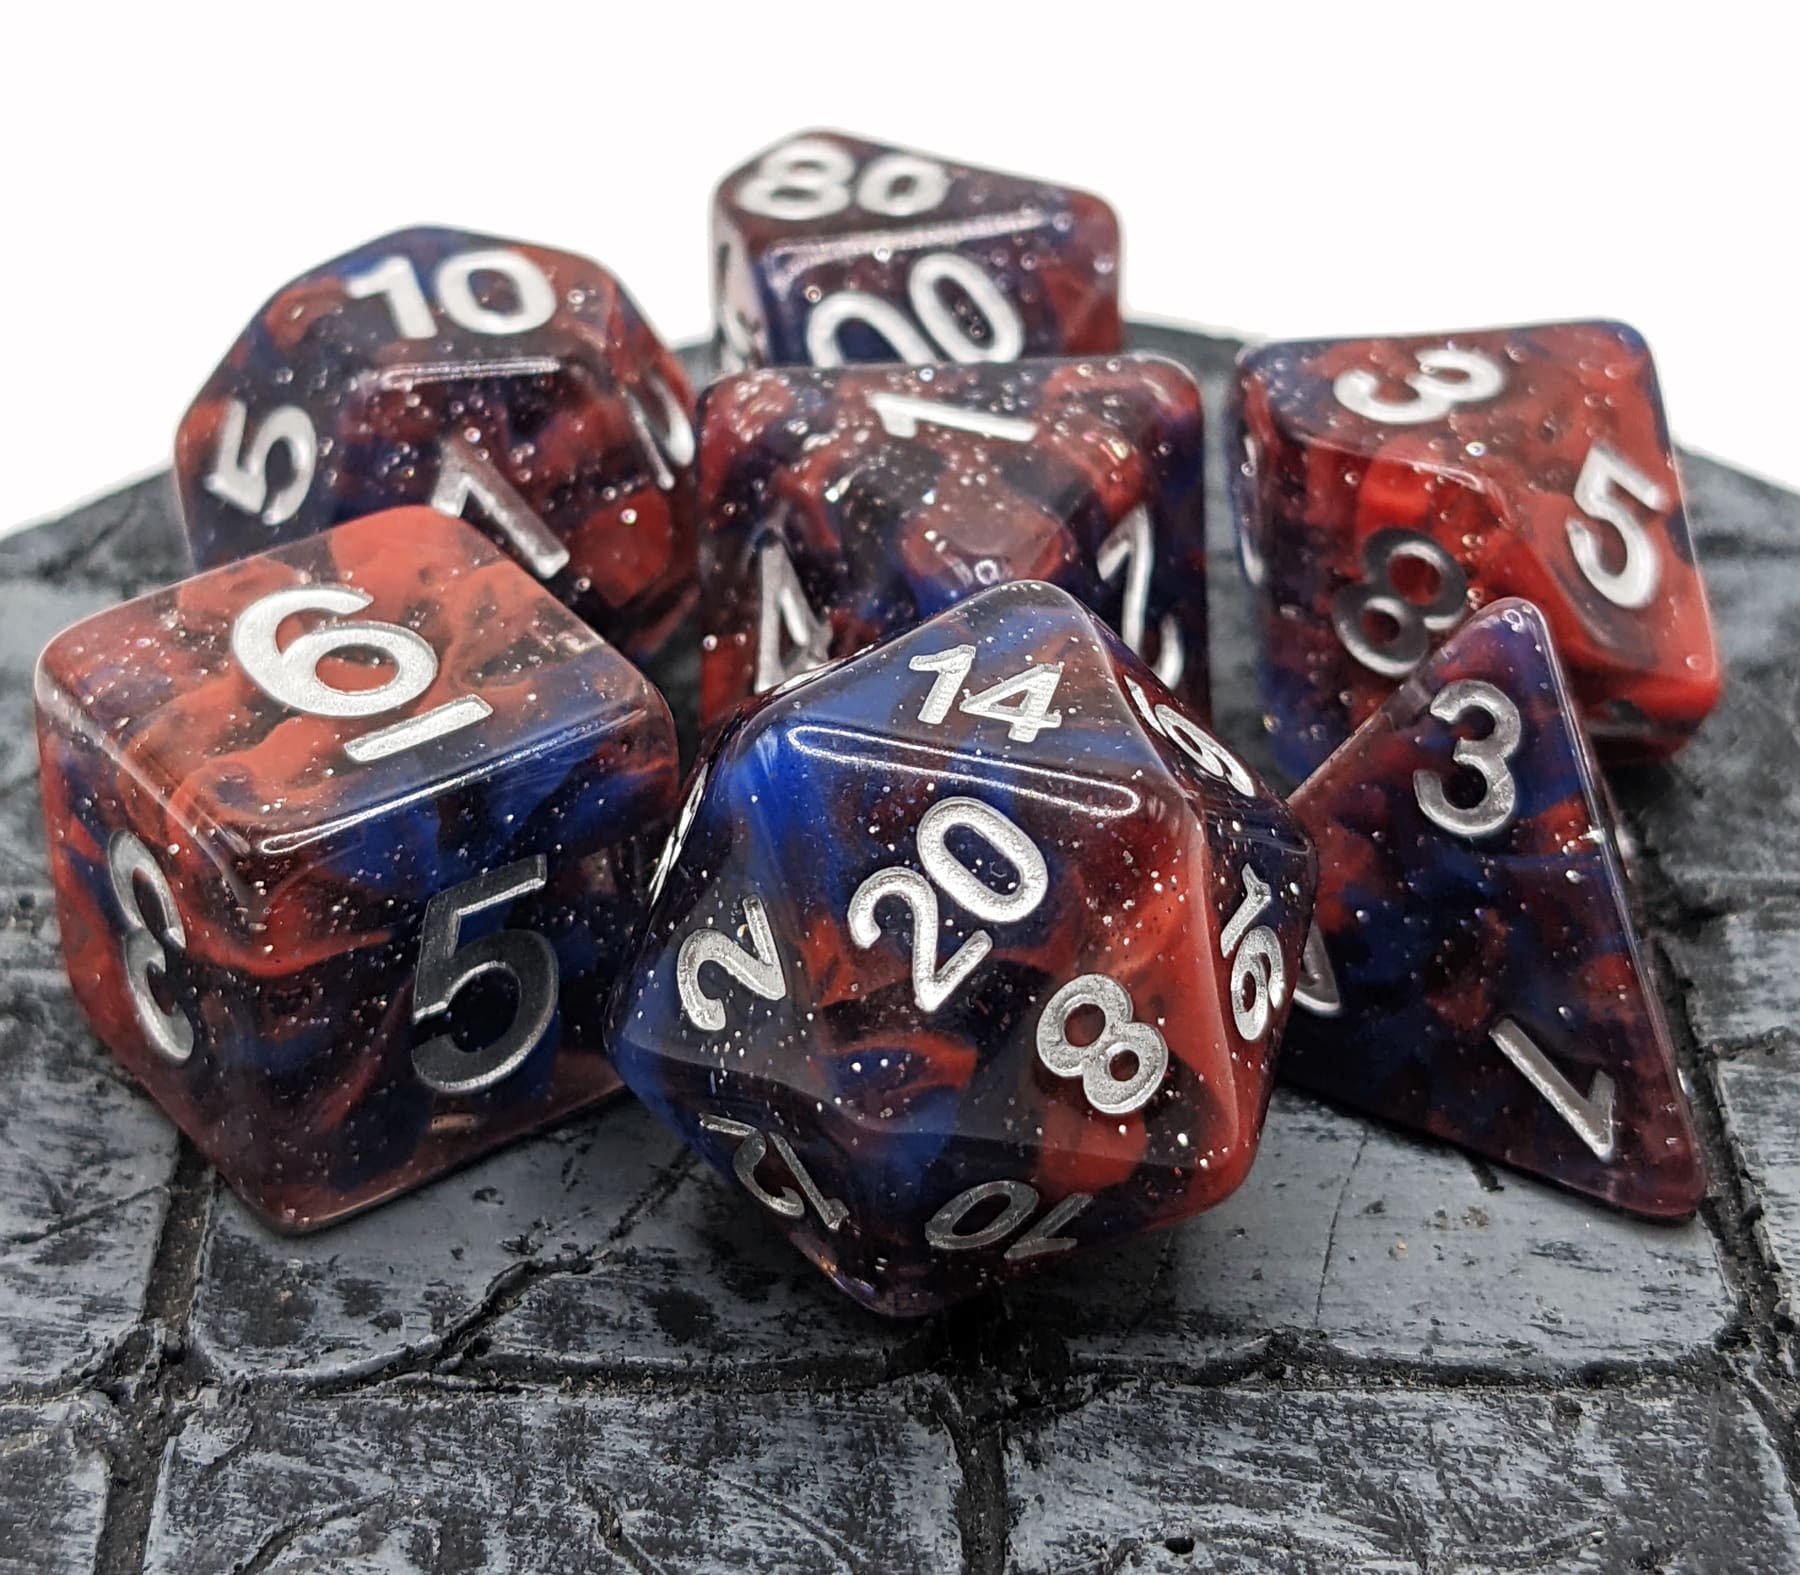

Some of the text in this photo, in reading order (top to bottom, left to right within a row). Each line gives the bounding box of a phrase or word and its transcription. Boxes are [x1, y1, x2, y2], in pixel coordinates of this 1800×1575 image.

[735, 137, 952, 221] 80
[345, 250, 556, 339] 10
[1334, 347, 1504, 425] 3
[204, 400, 317, 525] 5
[1564, 443, 1665, 609] 5
[232, 585, 438, 717] 6
[1332, 526, 1467, 677] 8
[910, 644, 1067, 743] 14
[1413, 679, 1522, 837] 3
[107, 830, 194, 1062] 3
[411, 854, 560, 1093] 5
[676, 896, 787, 1032] 2
[847, 796, 1048, 1012] 20
[1036, 973, 1169, 1115] 8
[1488, 1018, 1616, 1162] 1
